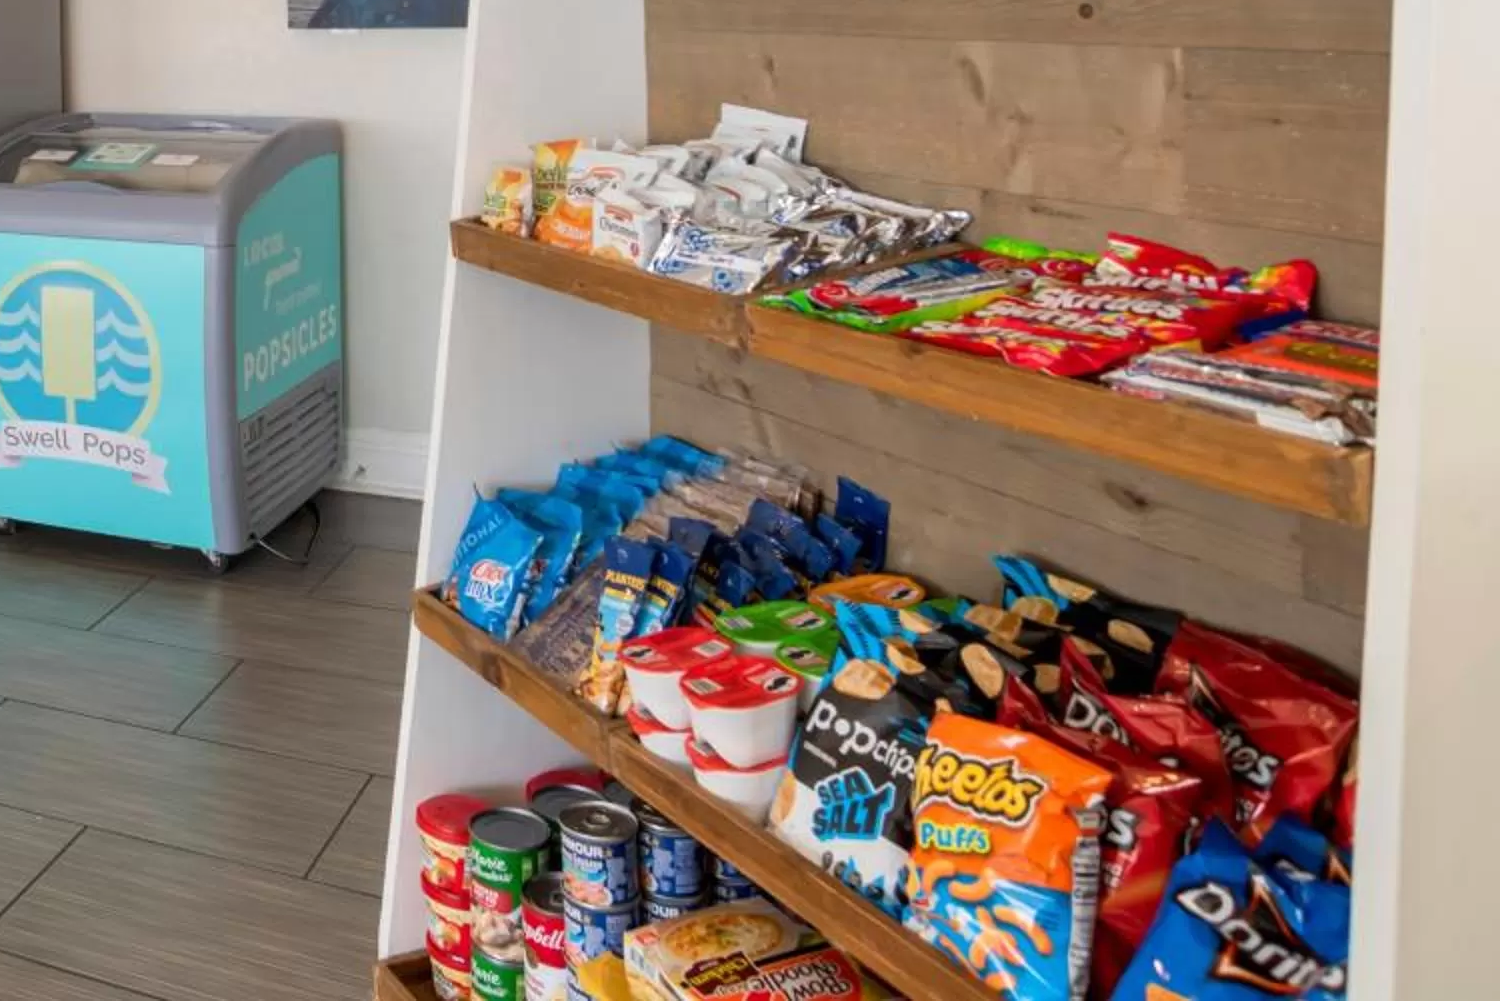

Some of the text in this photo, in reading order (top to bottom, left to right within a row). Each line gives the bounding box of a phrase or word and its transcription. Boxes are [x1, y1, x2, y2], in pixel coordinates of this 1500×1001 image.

[243, 303, 337, 392] POPSICLES
[4, 425, 146, 466] Swell Pops
[605, 568, 648, 591] PLANTERS
[816, 768, 873, 808] SEA
[914, 745, 1045, 821] heetos
[812, 786, 892, 840] SALT
[919, 821, 990, 854] Puffs
[752, 962, 840, 992] Noodle
